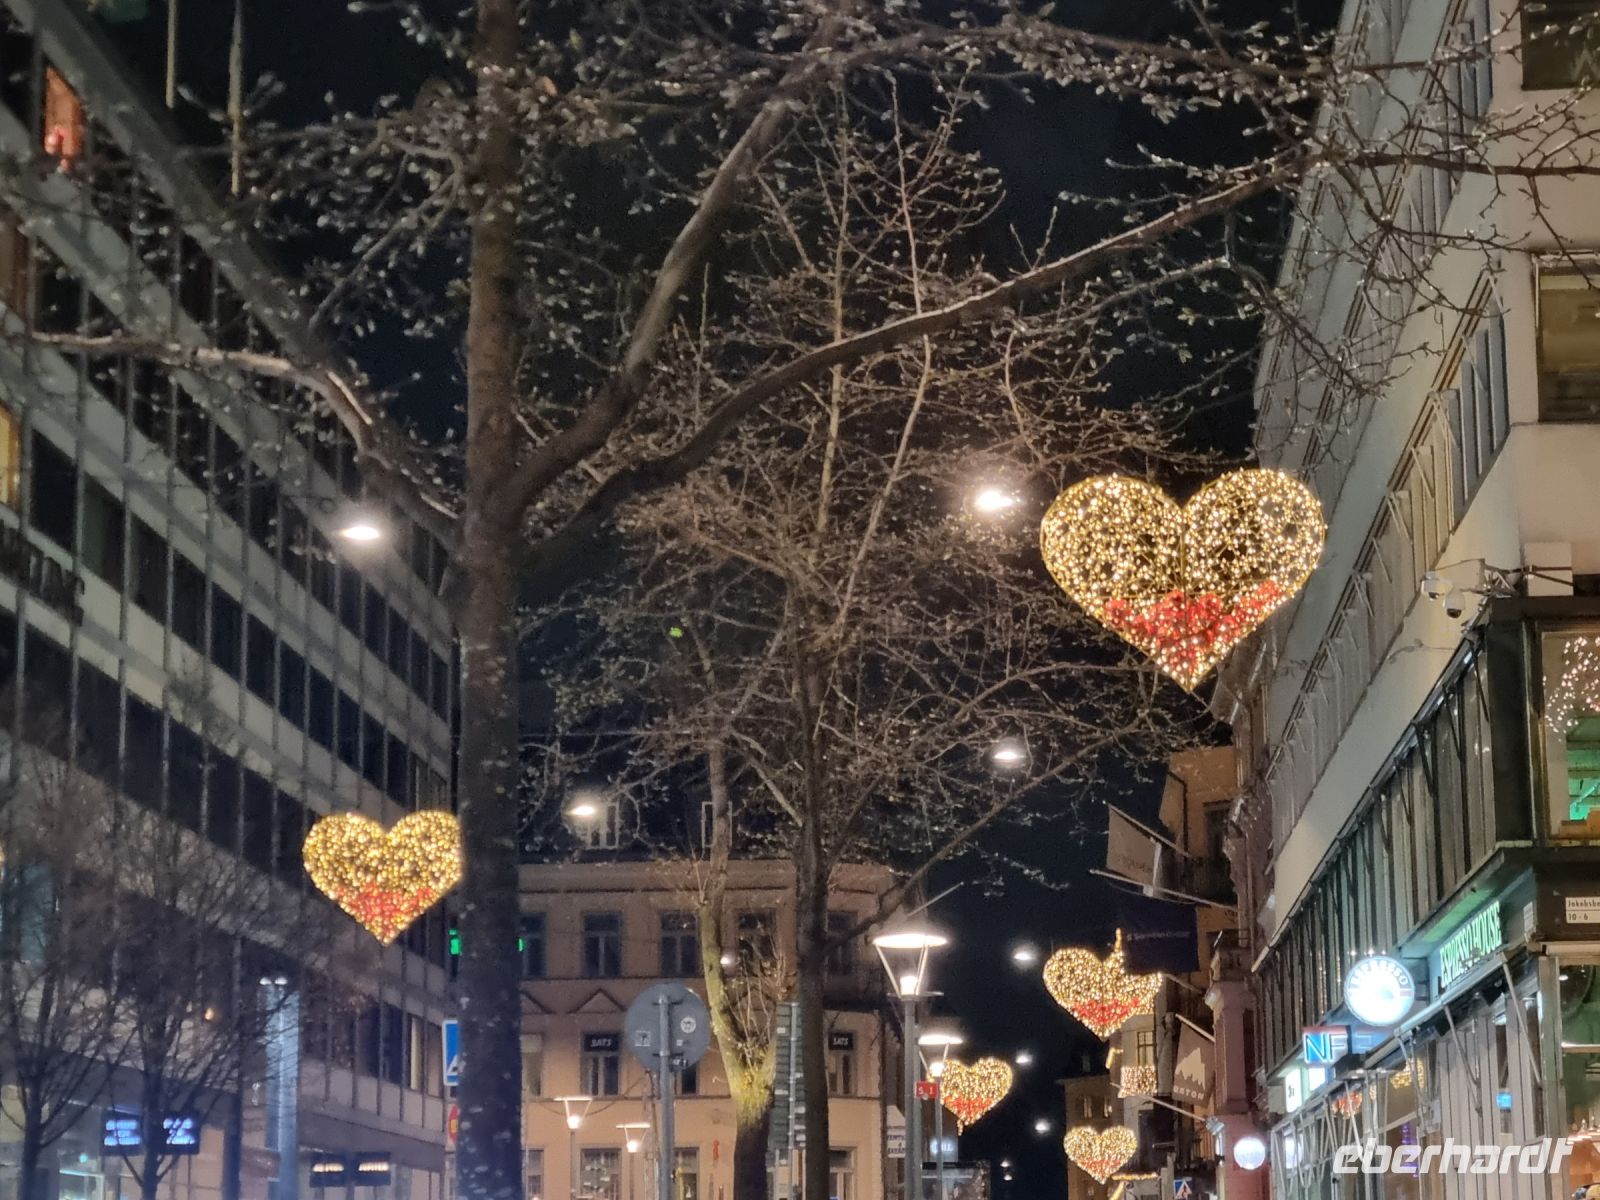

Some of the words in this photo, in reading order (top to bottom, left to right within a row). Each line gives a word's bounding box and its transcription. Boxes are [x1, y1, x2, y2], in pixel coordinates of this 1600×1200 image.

[1471, 901, 1502, 962] HOUSE
[1568, 913, 1577, 921] 10
[1584, 913, 1588, 921] 6
